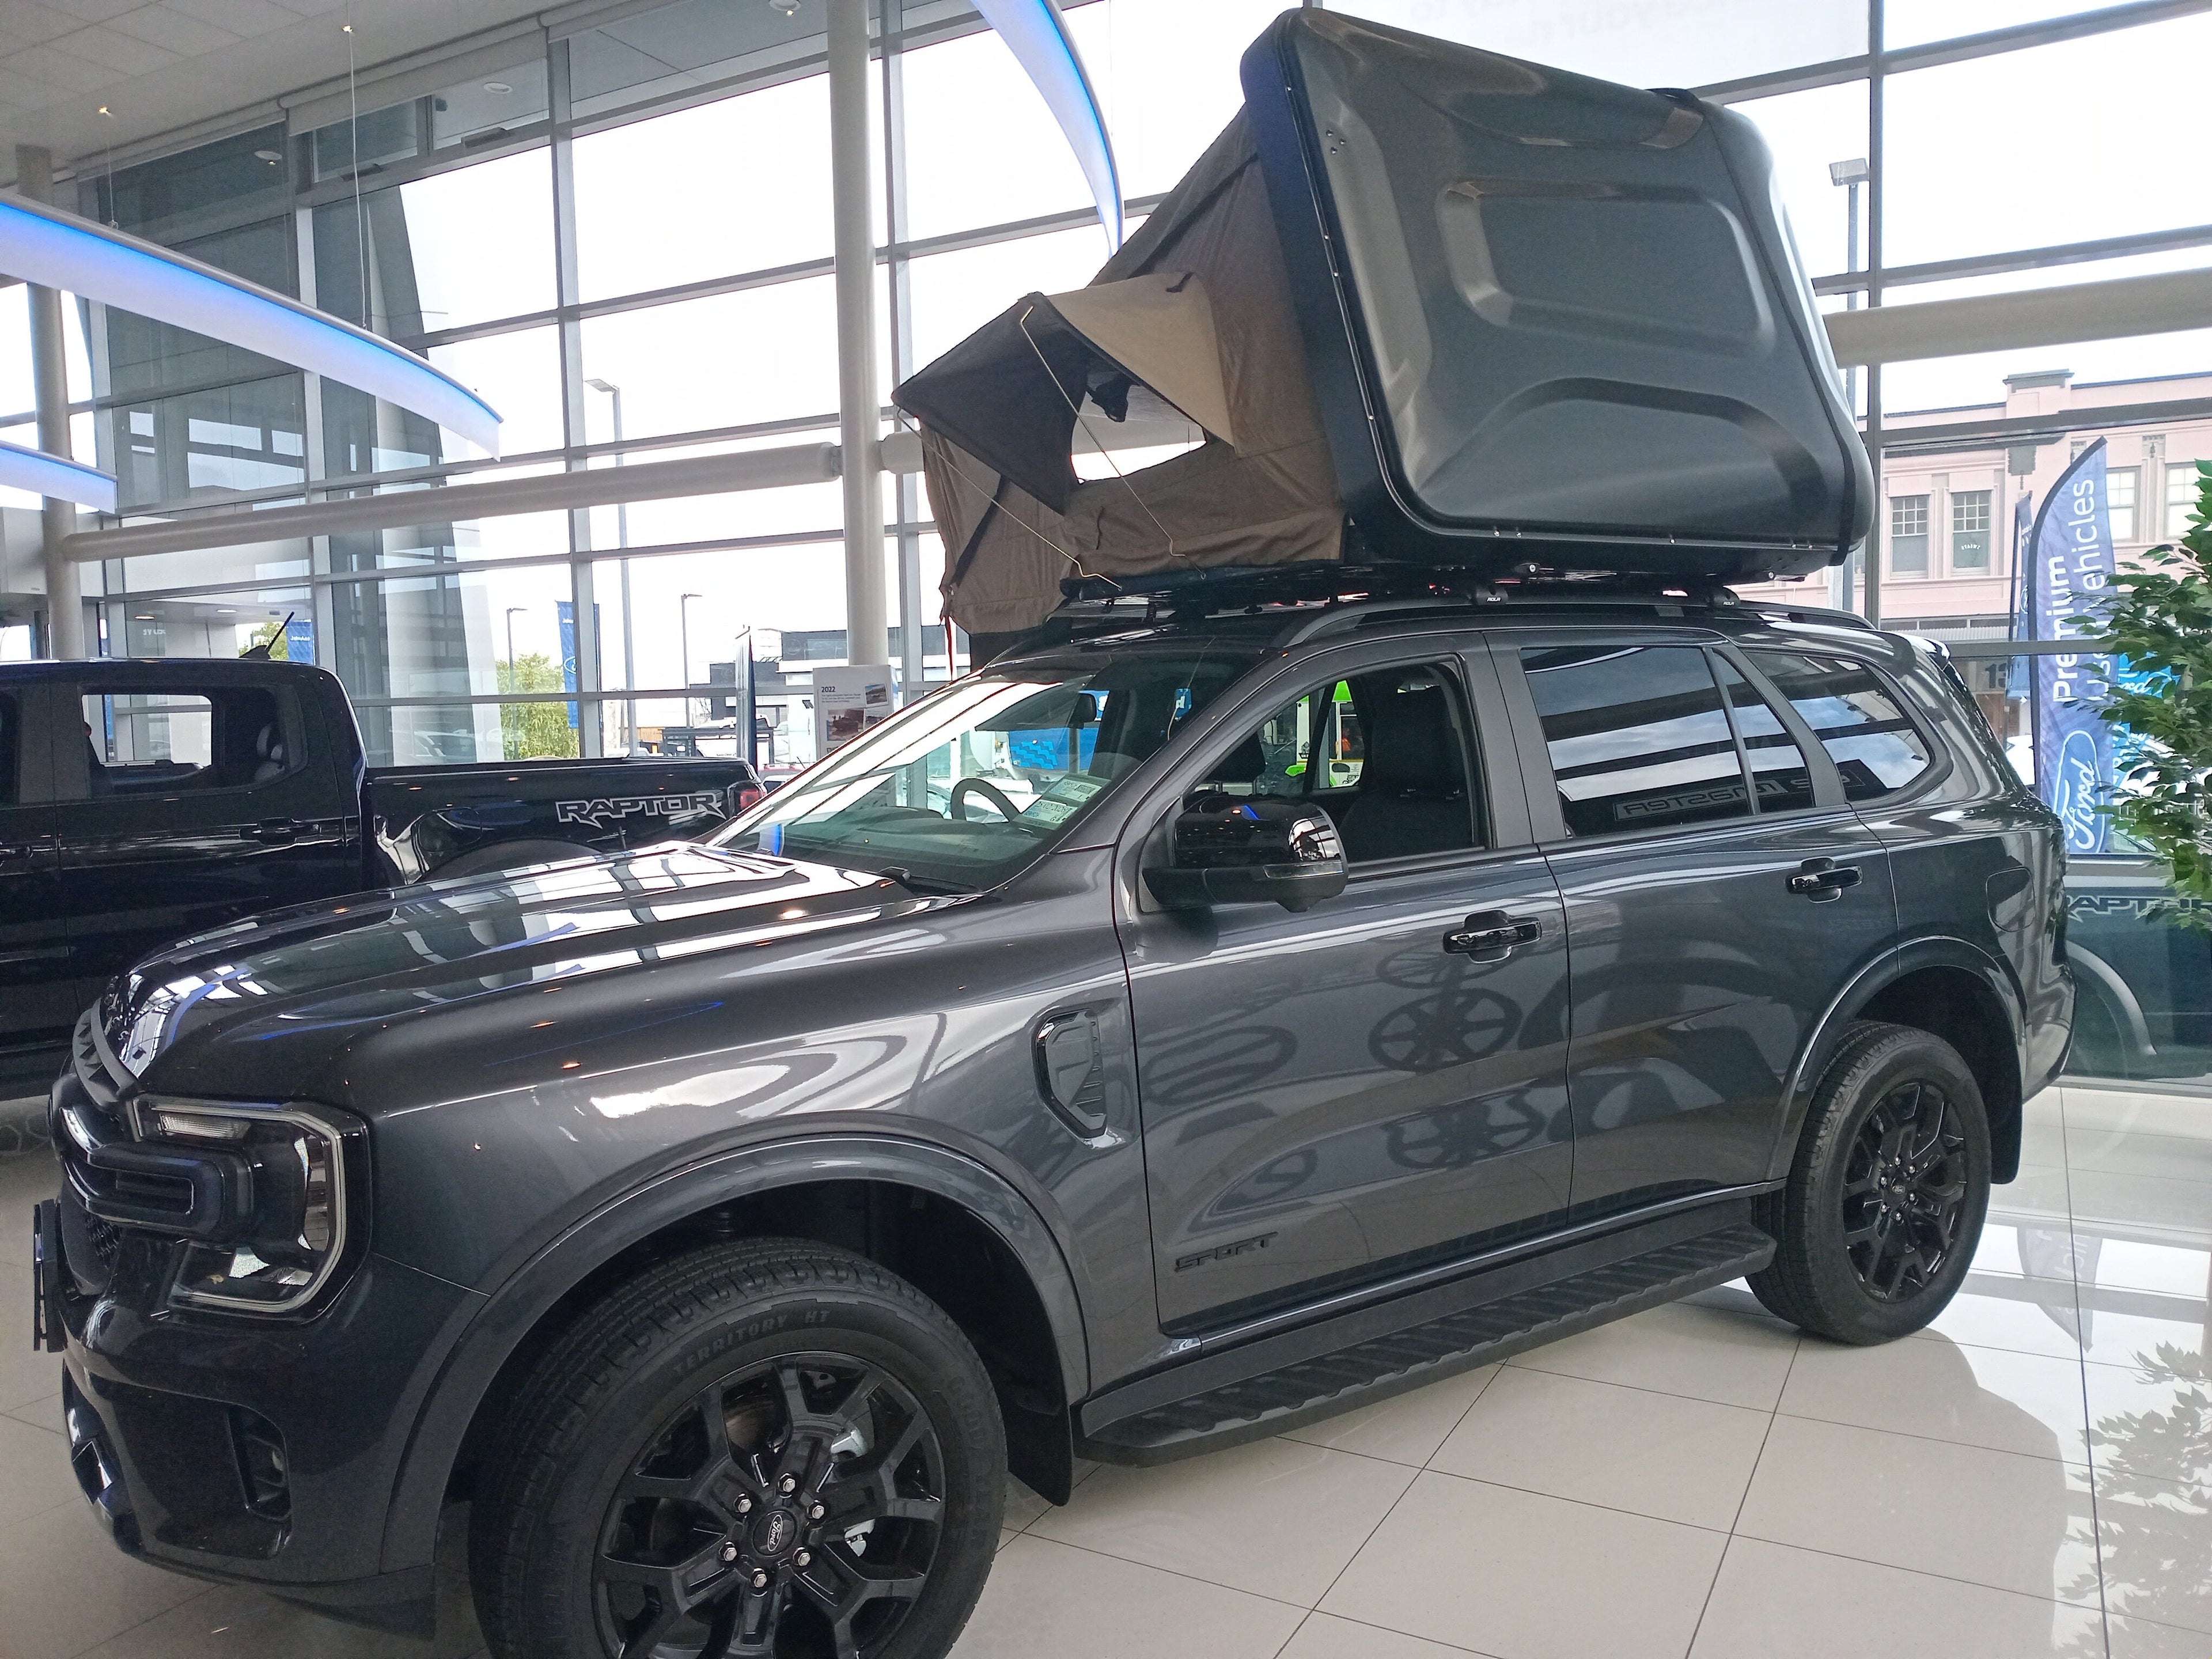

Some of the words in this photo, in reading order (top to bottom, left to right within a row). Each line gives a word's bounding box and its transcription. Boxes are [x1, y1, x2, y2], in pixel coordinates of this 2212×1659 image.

[2046, 555, 2078, 702] Premium
[555, 793, 727, 830] RAPTOR
[2061, 757, 2096, 850] Ford
[1174, 1231, 1279, 1273] SPORT
[673, 1315, 788, 1377] TERRITORY
[805, 1310, 831, 1323] HT
[769, 1521, 781, 1545] Ford
